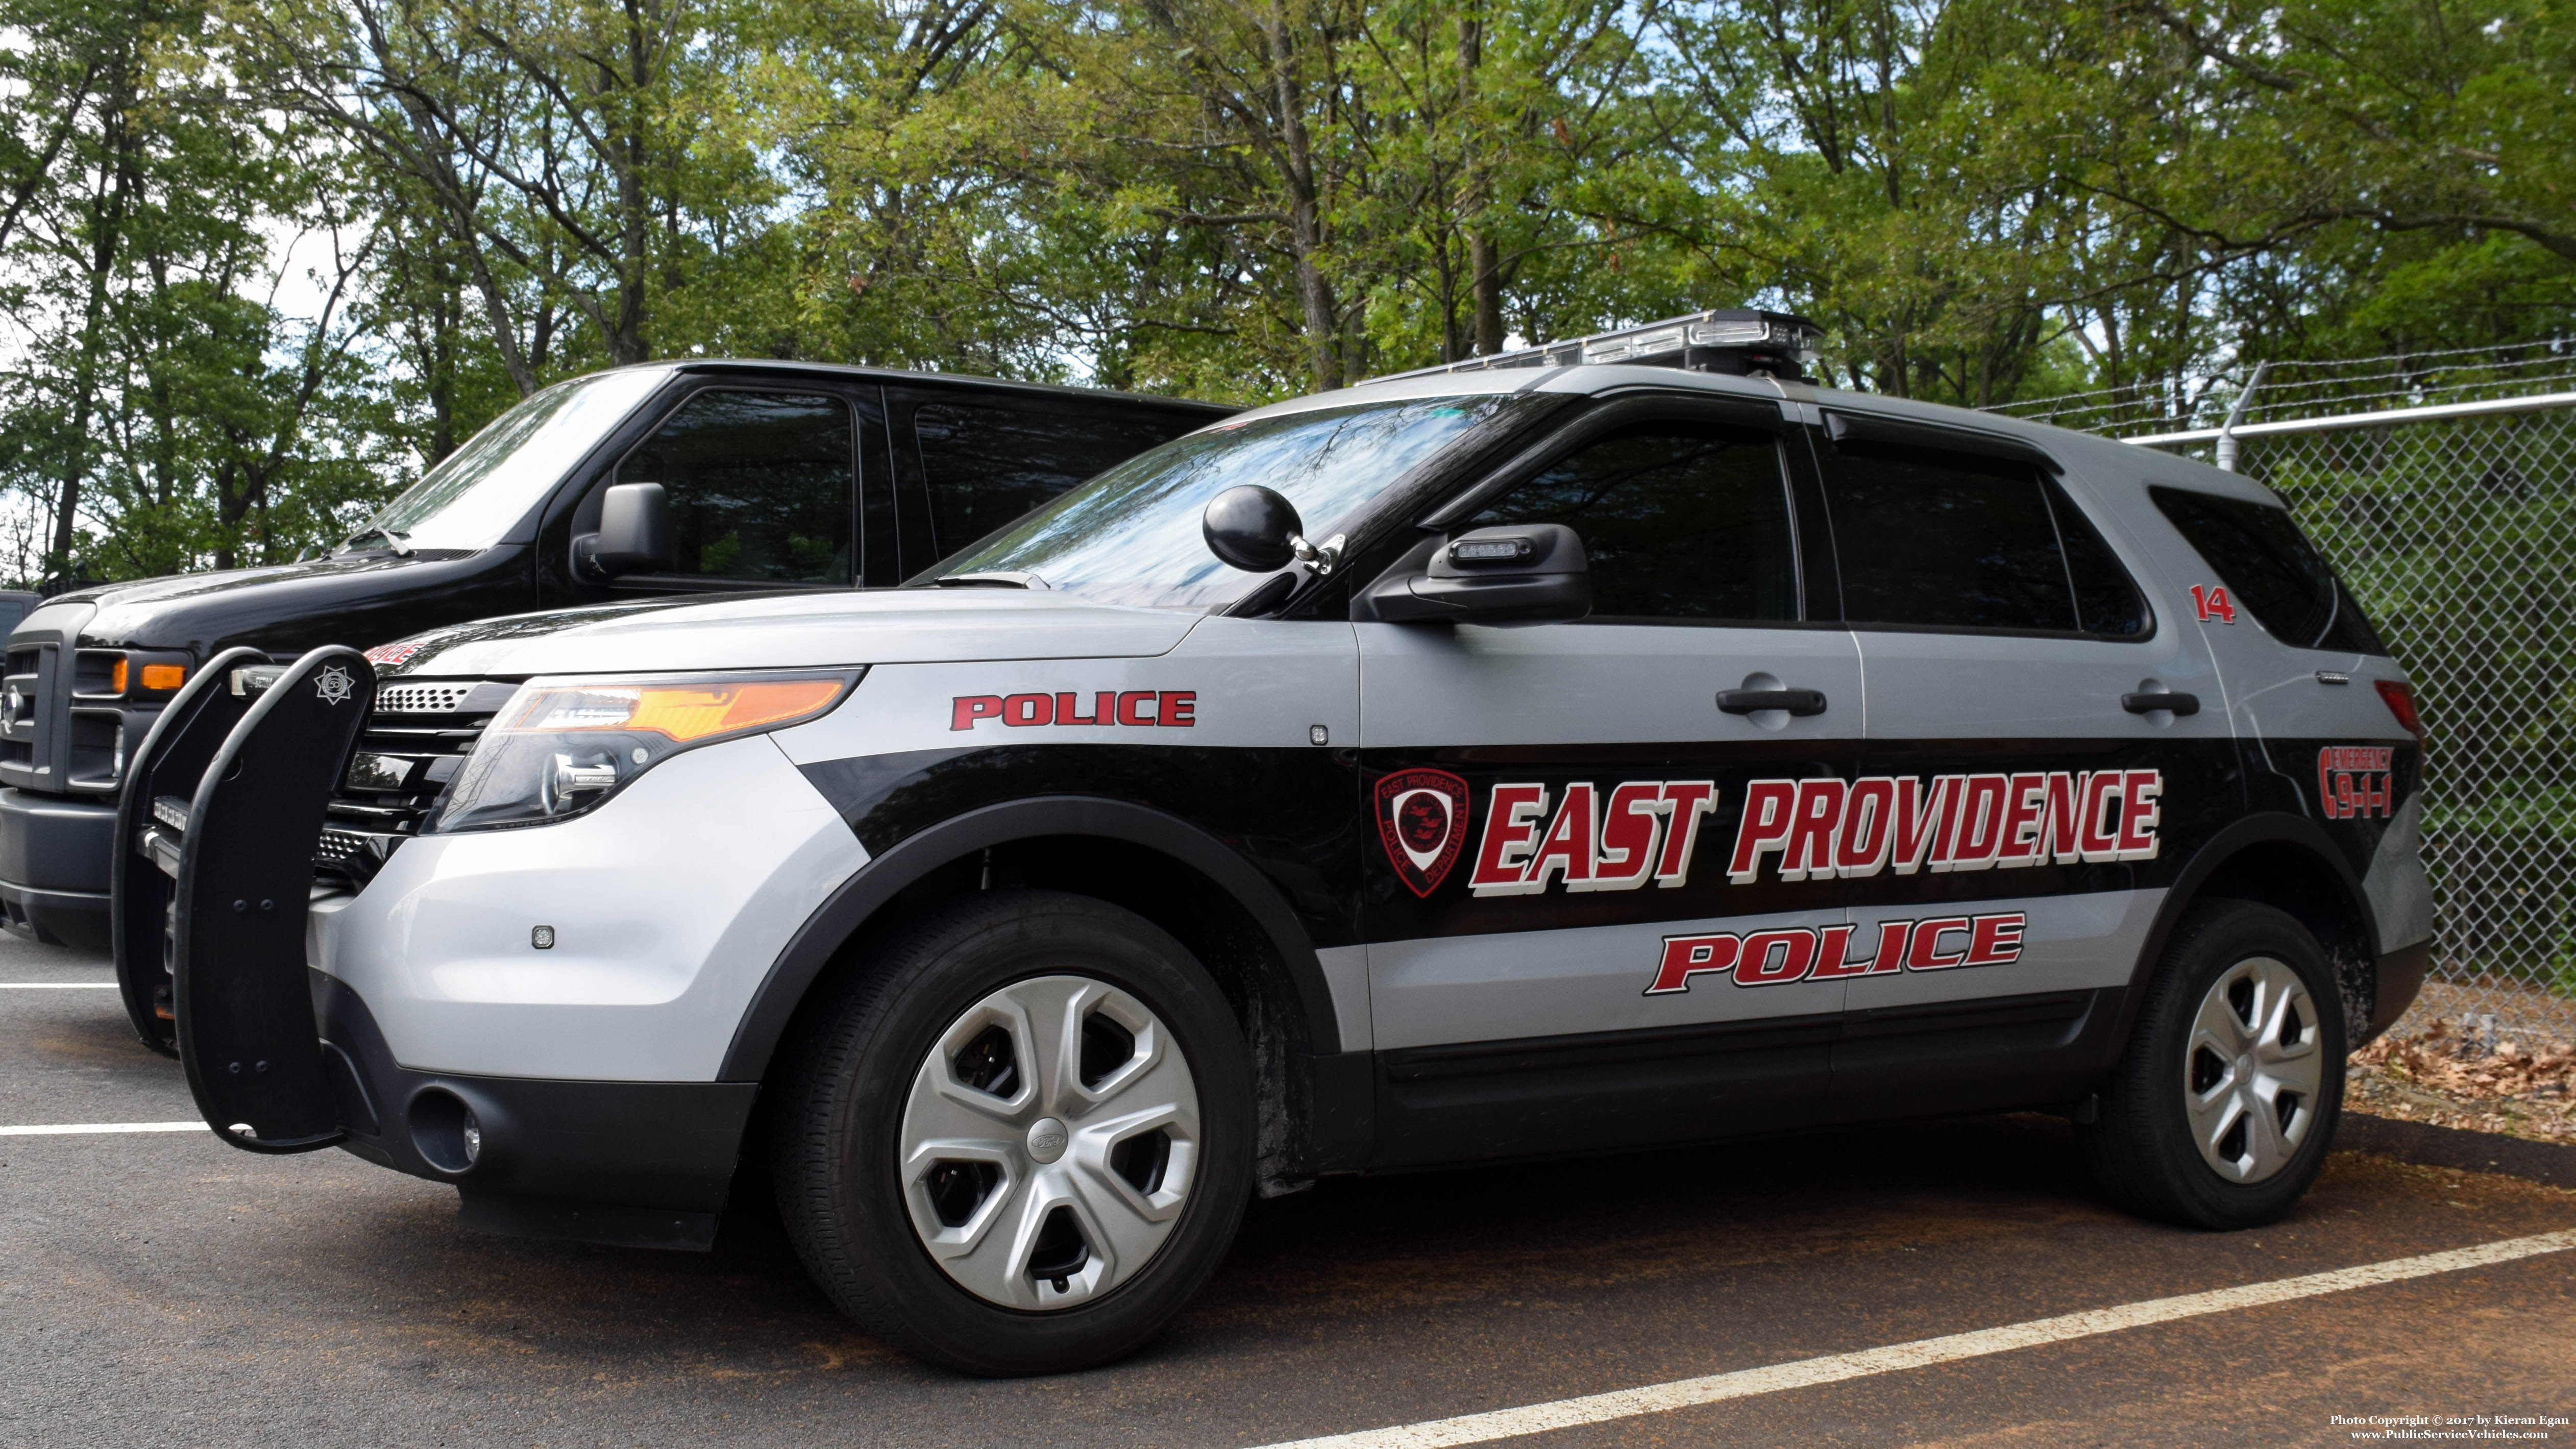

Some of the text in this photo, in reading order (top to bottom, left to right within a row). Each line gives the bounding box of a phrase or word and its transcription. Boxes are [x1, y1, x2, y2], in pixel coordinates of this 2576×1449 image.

[2189, 584, 2236, 625] 14
[329, 680, 340, 689] 50
[950, 691, 1196, 731] POLICE
[2332, 746, 2395, 772] EMERGENCY
[1381, 774, 1464, 799] EAST PROVIDENCE
[2336, 772, 2392, 819] 9-1-1
[1383, 819, 1412, 872] POLICE
[1425, 802, 1464, 884] DEPARTMENT
[1468, 769, 2163, 897] EAST PROVIDENCE
[1642, 911, 2025, 996] POLICE
[1037, 1135, 1063, 1148] Ford
